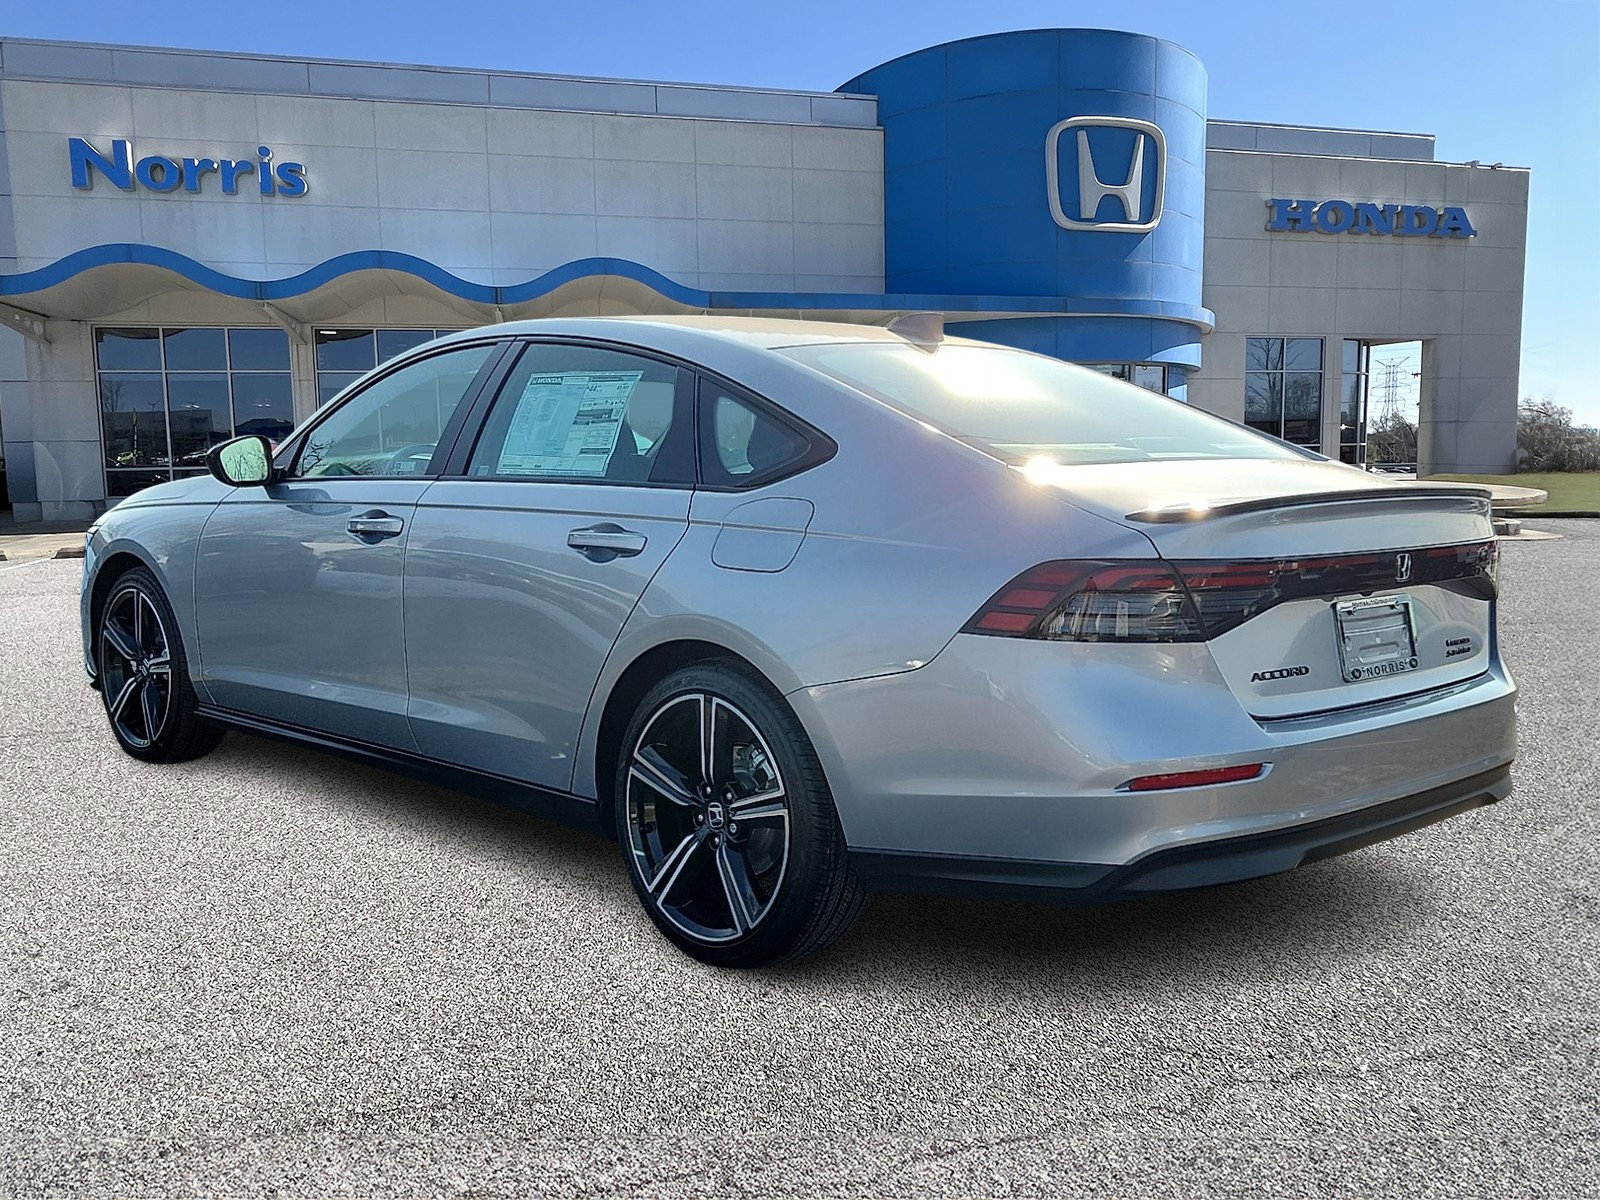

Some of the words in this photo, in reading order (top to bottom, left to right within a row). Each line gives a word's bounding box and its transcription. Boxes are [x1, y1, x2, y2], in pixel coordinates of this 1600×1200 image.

[68, 137, 309, 198] Norris
[1265, 198, 1477, 239] HONDA
[1250, 665, 1309, 683] ACCORD
[1366, 660, 1405, 677] NORRIS
